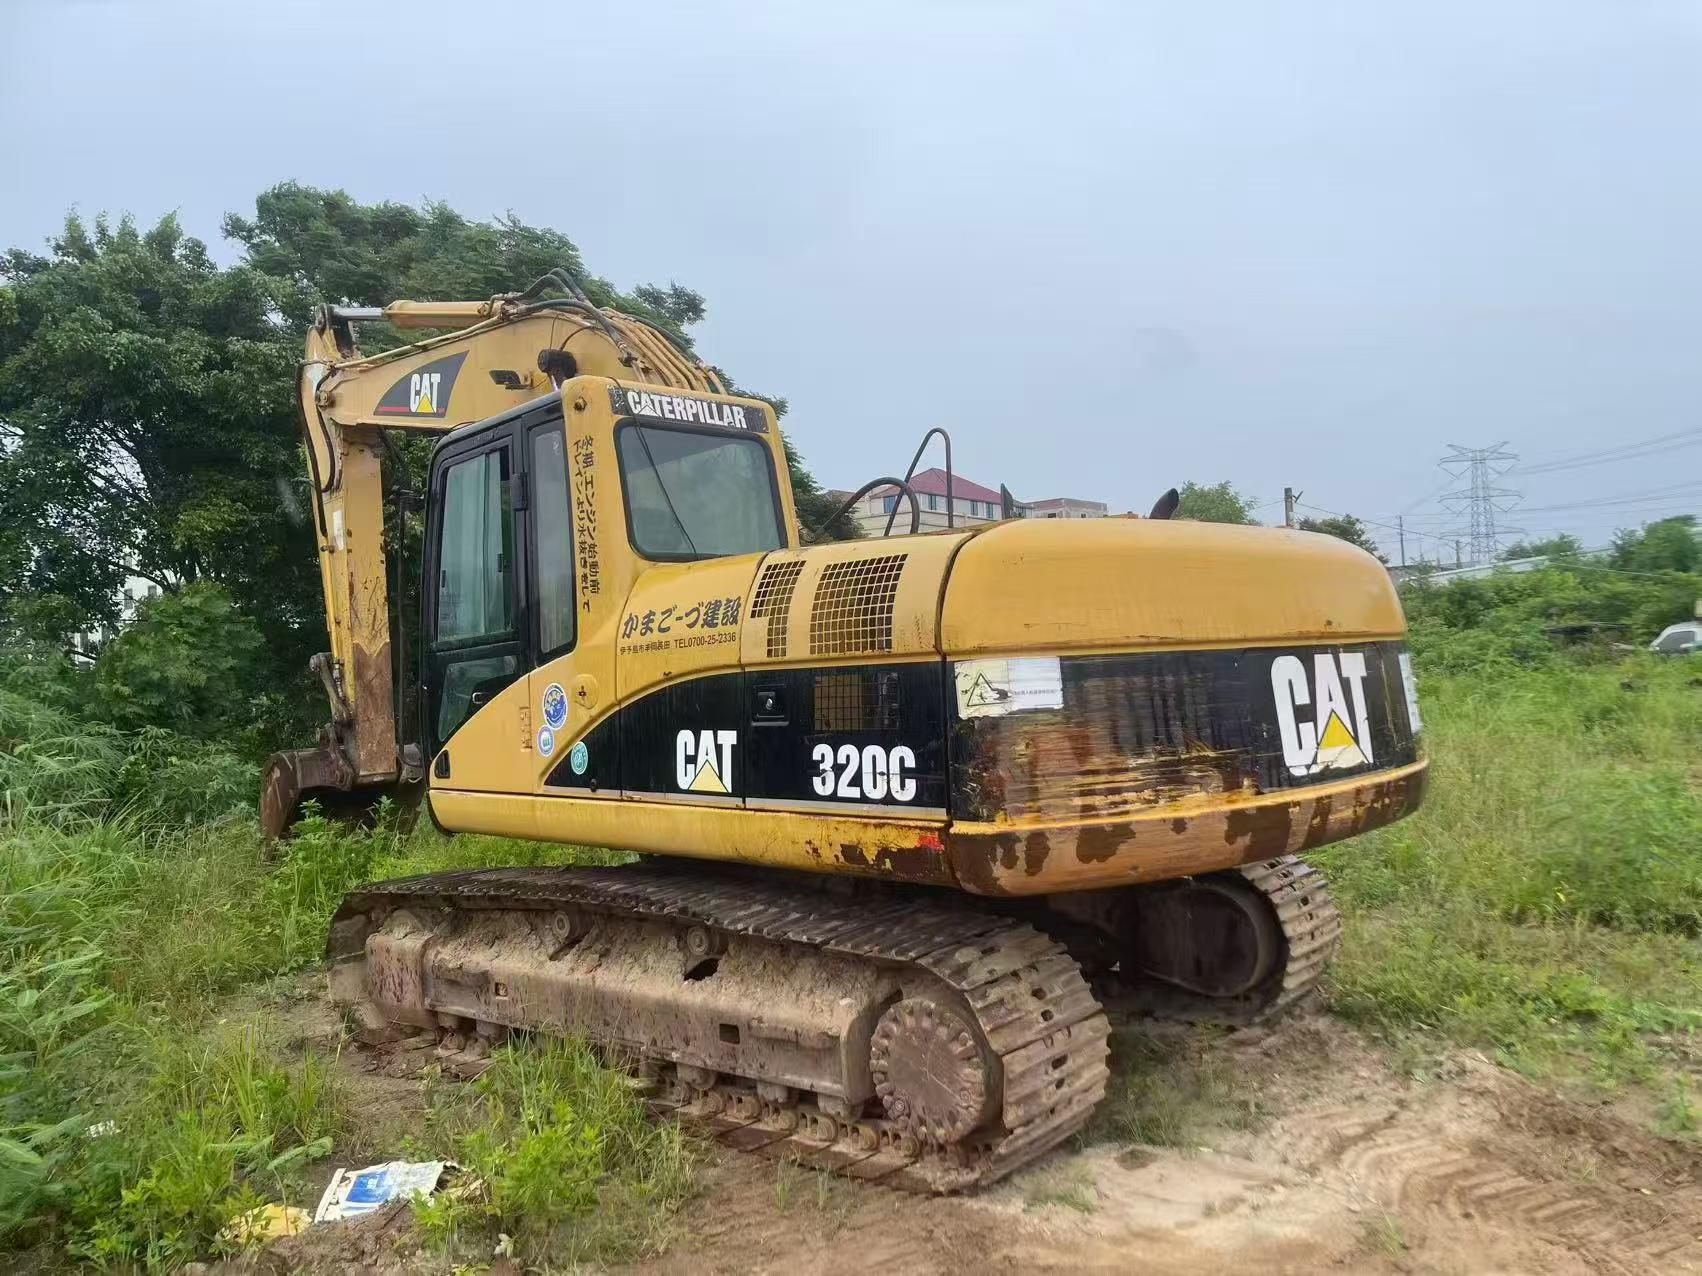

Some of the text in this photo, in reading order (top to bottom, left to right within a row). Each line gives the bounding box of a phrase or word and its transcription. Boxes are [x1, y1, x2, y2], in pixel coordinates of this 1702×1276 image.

[410, 373, 441, 413] CAT
[627, 390, 747, 429] CATERPILLAR
[1270, 652, 1374, 776] CAT
[676, 729, 738, 793] CAT
[812, 743, 917, 802] 320C
